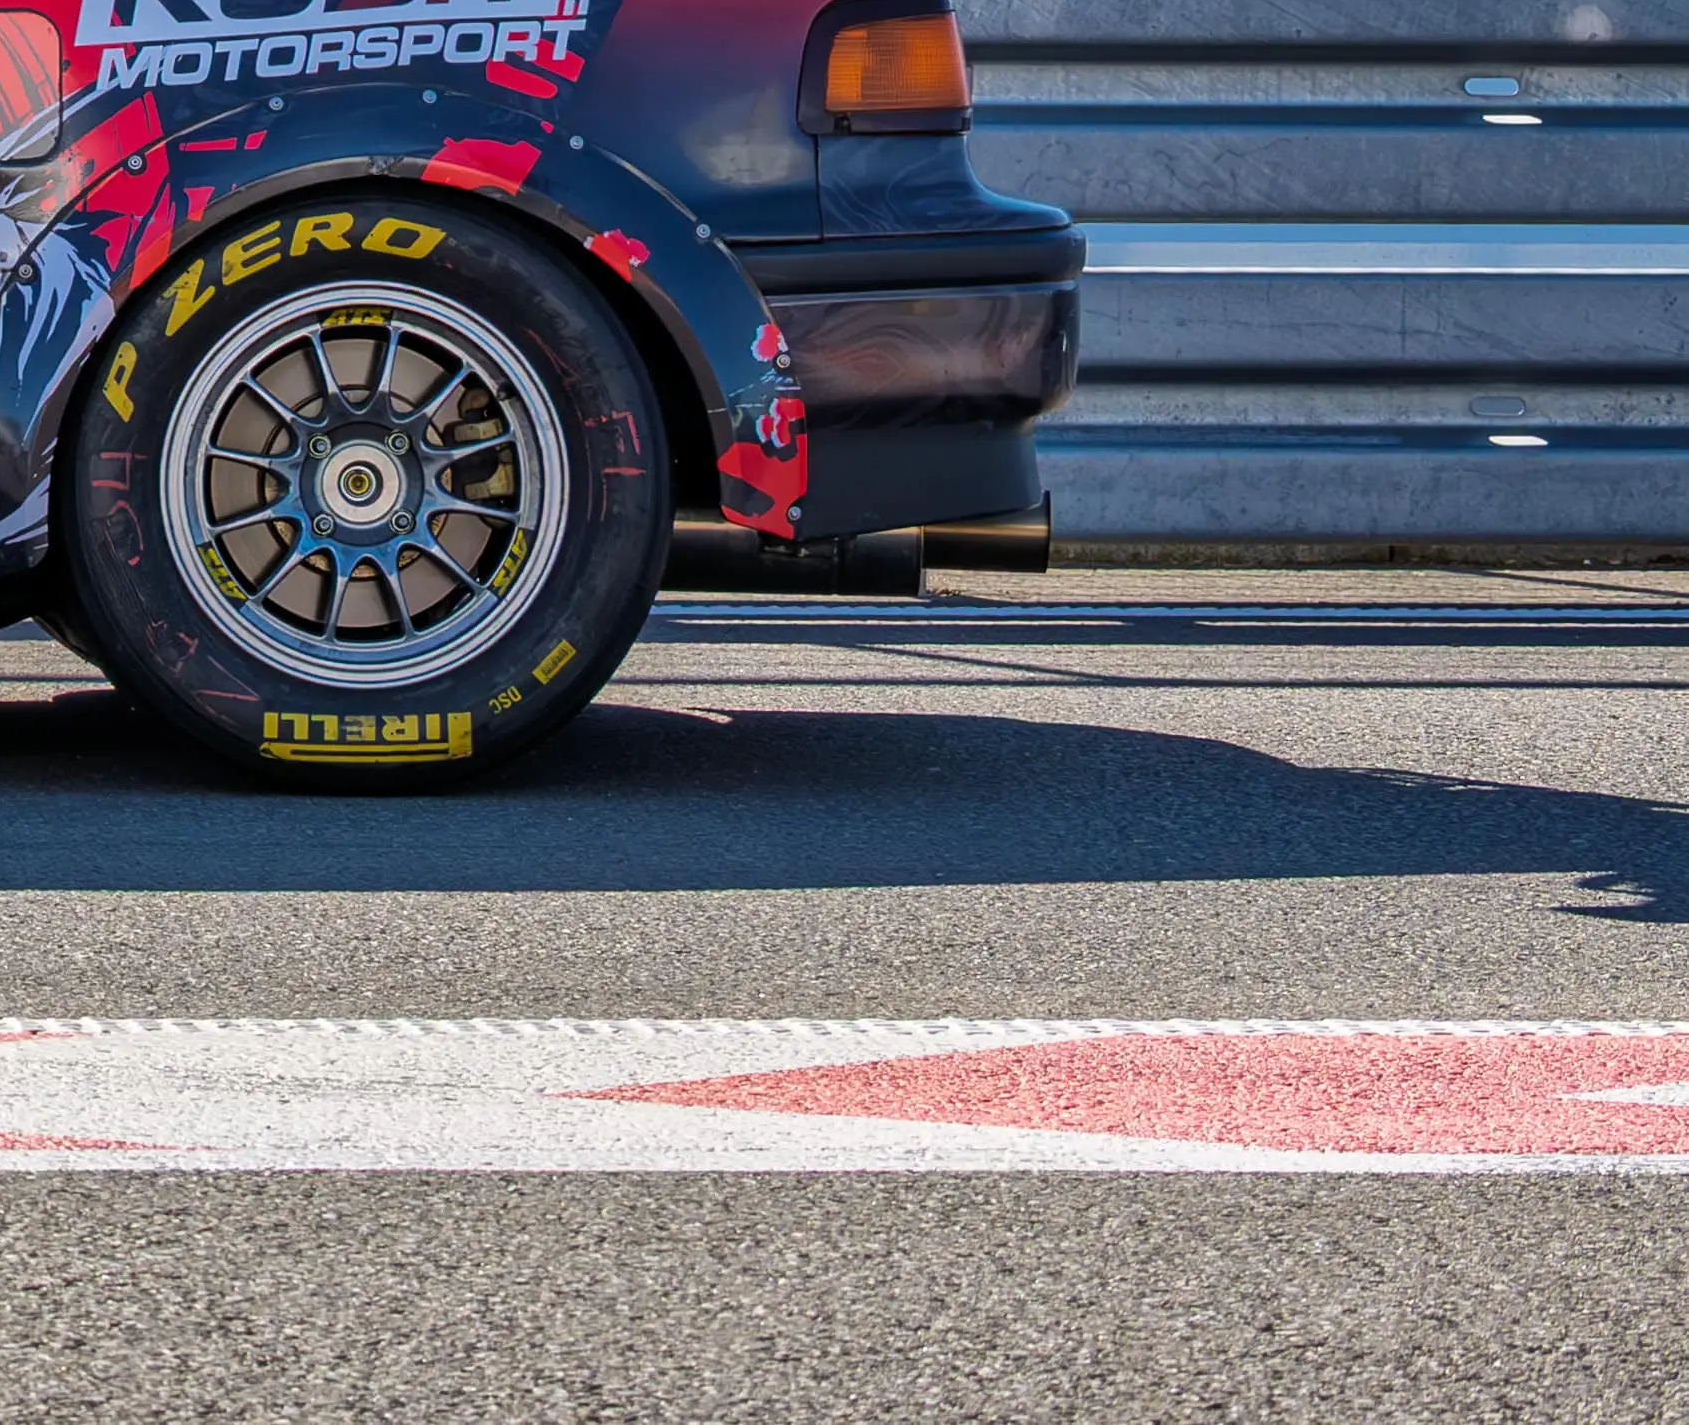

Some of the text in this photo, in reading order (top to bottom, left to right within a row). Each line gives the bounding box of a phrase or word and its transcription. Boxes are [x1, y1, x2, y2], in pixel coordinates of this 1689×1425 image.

[96, 19, 586, 91] MOTORSPORT
[101, 211, 449, 423] P ZERO
[258, 710, 473, 763] PIRELLI
